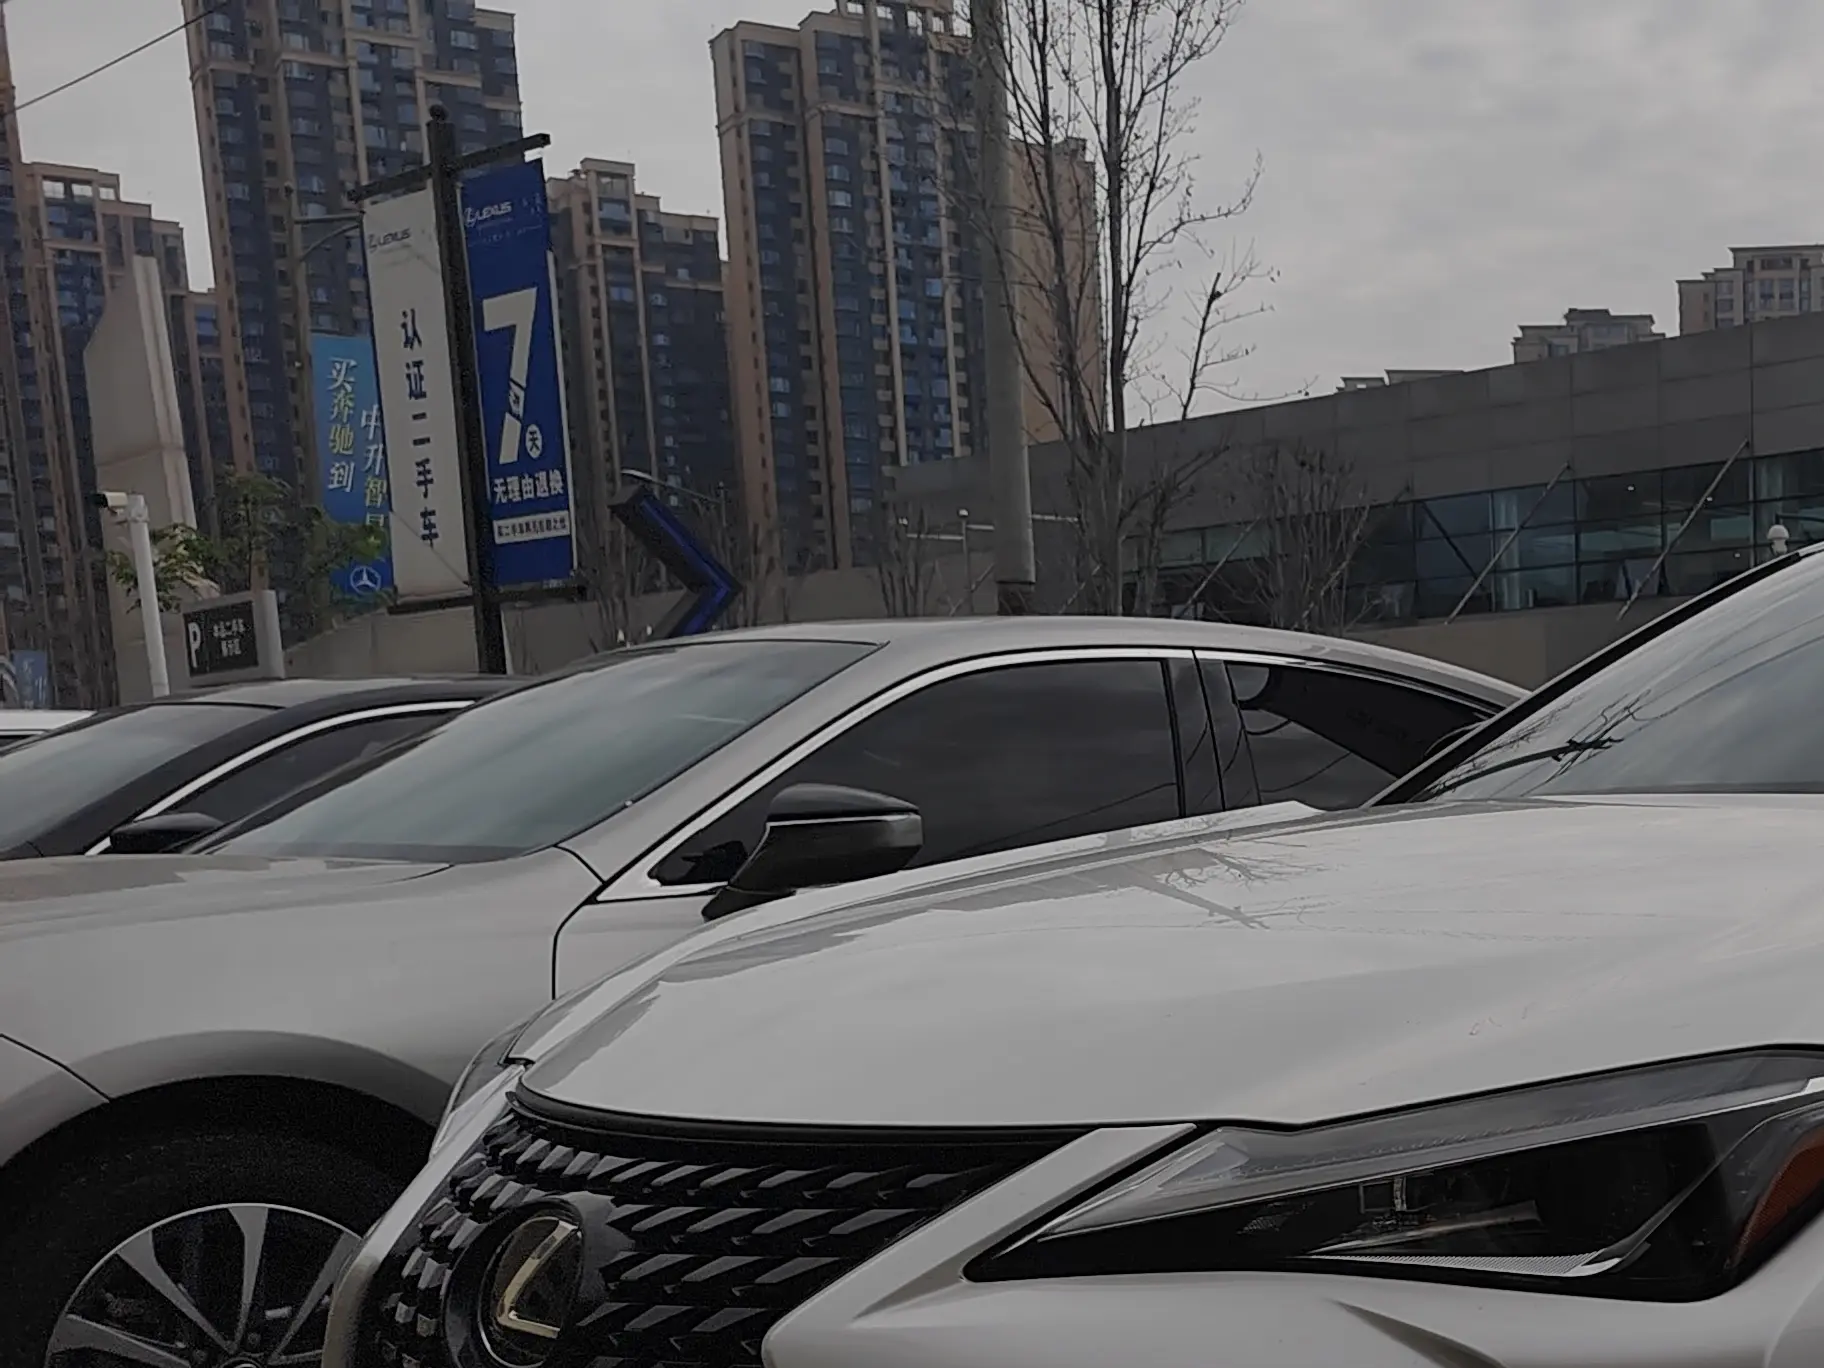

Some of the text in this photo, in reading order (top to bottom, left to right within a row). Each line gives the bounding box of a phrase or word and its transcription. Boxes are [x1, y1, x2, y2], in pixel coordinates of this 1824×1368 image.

[327, 356, 358, 493] 买奔驰到
[401, 308, 439, 548] 认证二手车
[493, 469, 565, 504] 无理由退换
[188, 621, 202, 669] P
